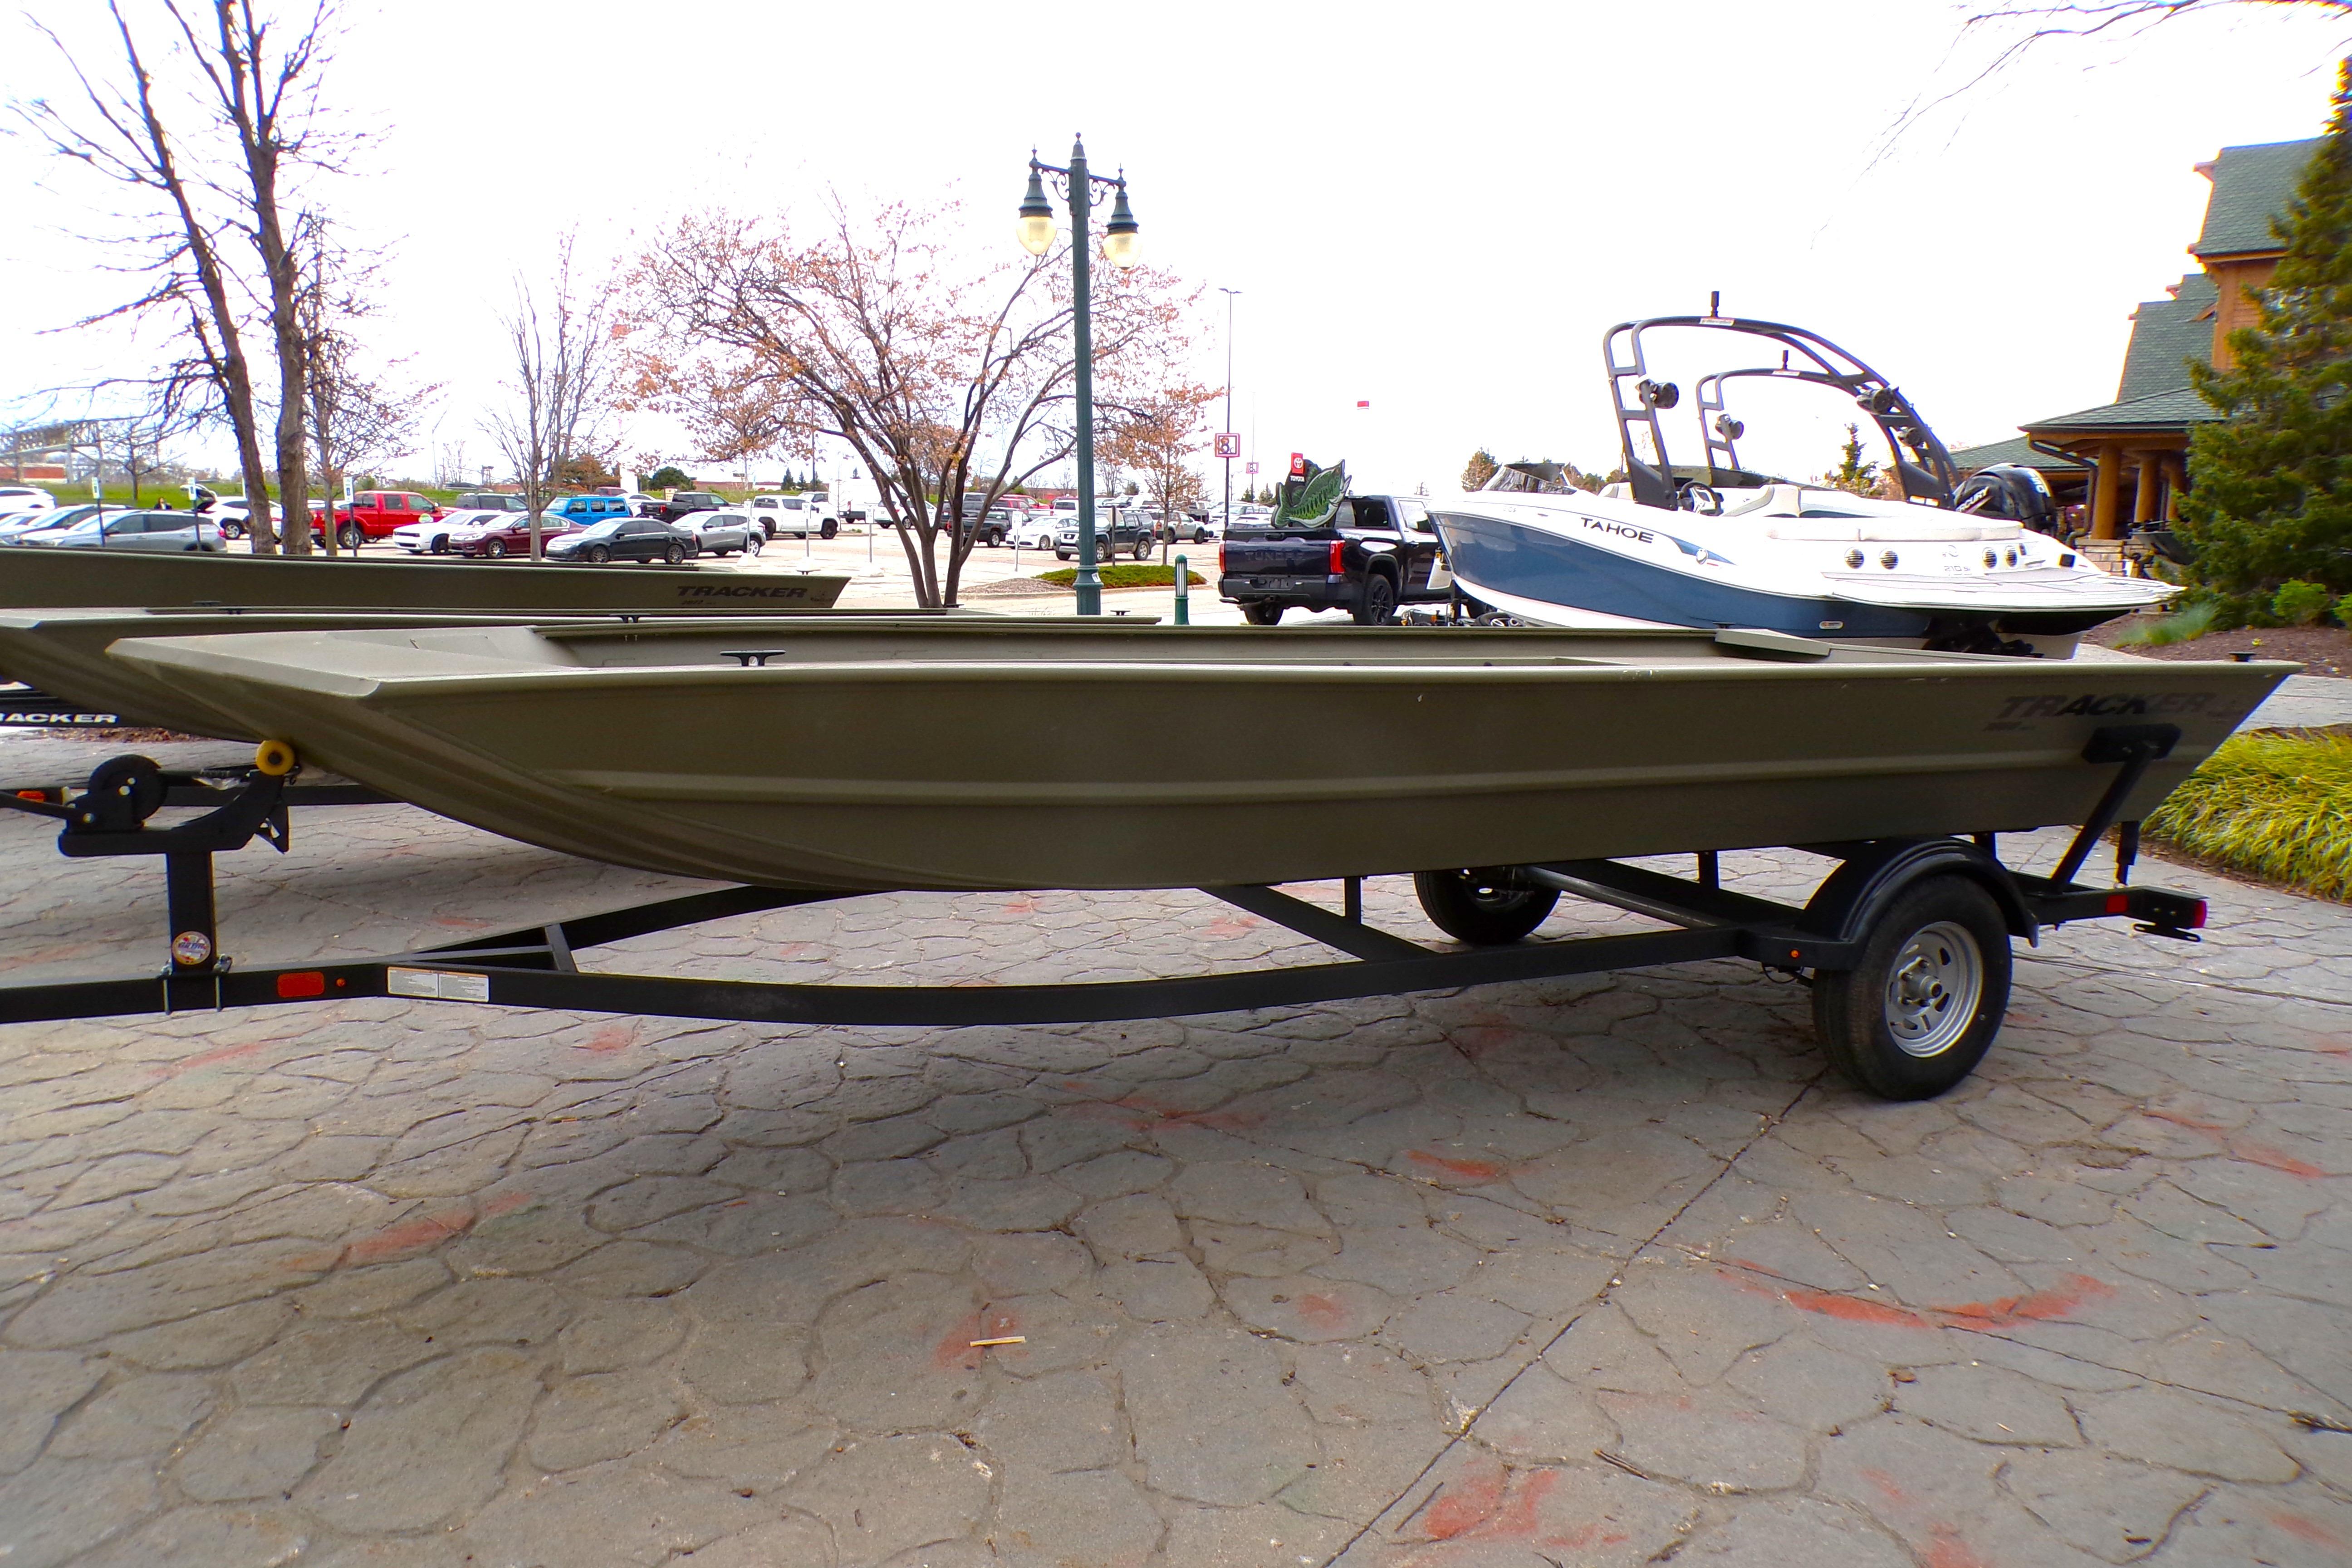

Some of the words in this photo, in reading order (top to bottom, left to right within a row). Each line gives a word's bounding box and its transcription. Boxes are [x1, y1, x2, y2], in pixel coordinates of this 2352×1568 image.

[1955, 486, 1990, 512] RCURY
[1581, 517, 1654, 544] TAHOE
[677, 586, 808, 598] TRACKER
[1996, 692, 2216, 718] TRACKER
